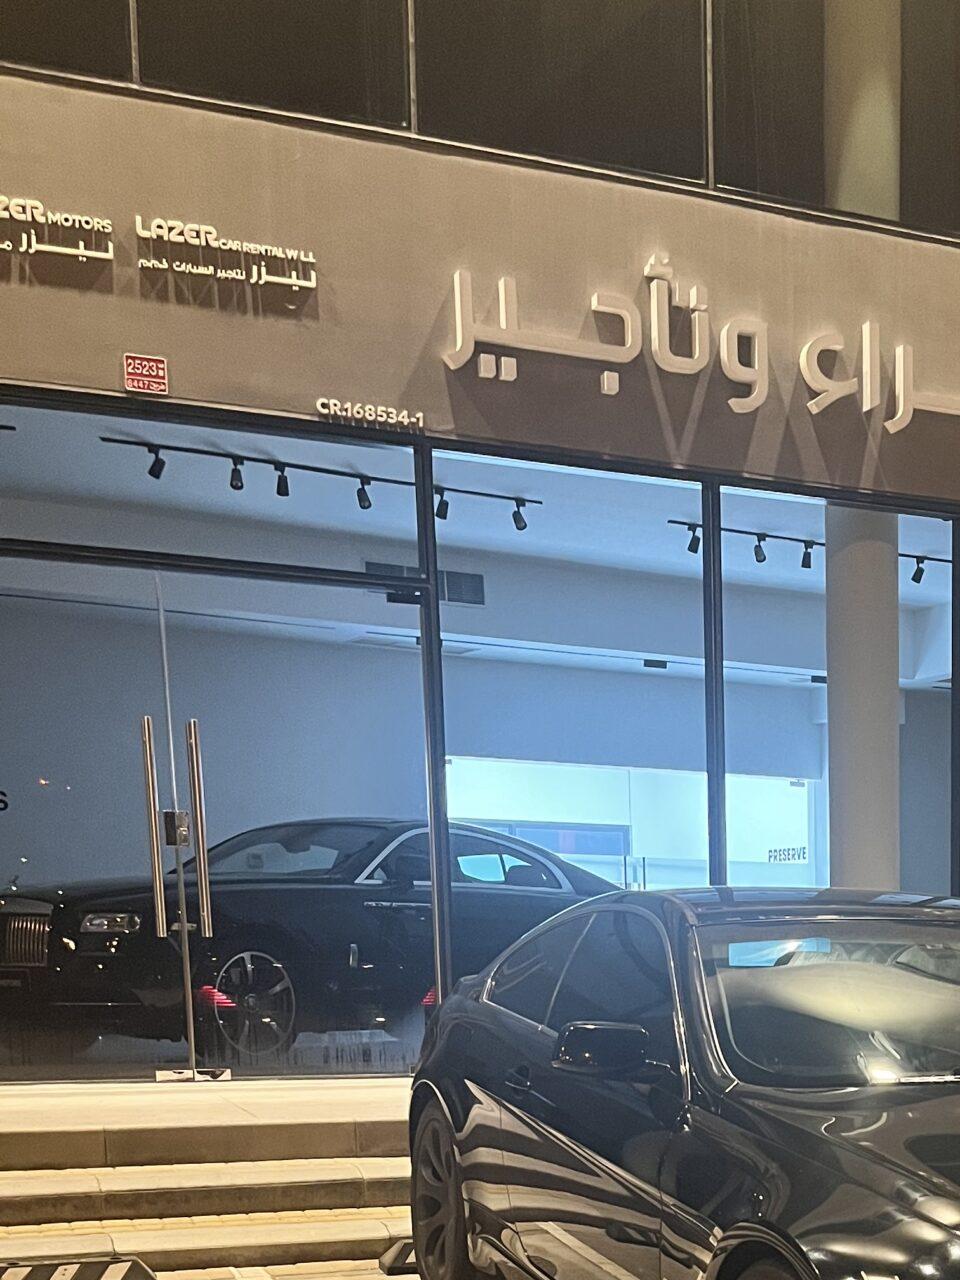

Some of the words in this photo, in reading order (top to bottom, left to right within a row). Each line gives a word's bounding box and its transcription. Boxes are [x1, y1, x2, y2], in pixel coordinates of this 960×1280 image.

[47, 211, 113, 233] MOTORS
[135, 215, 219, 248] LAZER
[219, 239, 241, 251] CAR
[242, 242, 286, 259] RENTAL
[127, 359, 157, 376] 2523
[316, 397, 424, 428] CR.168534-1
[768, 846, 807, 863] PRESERVE
